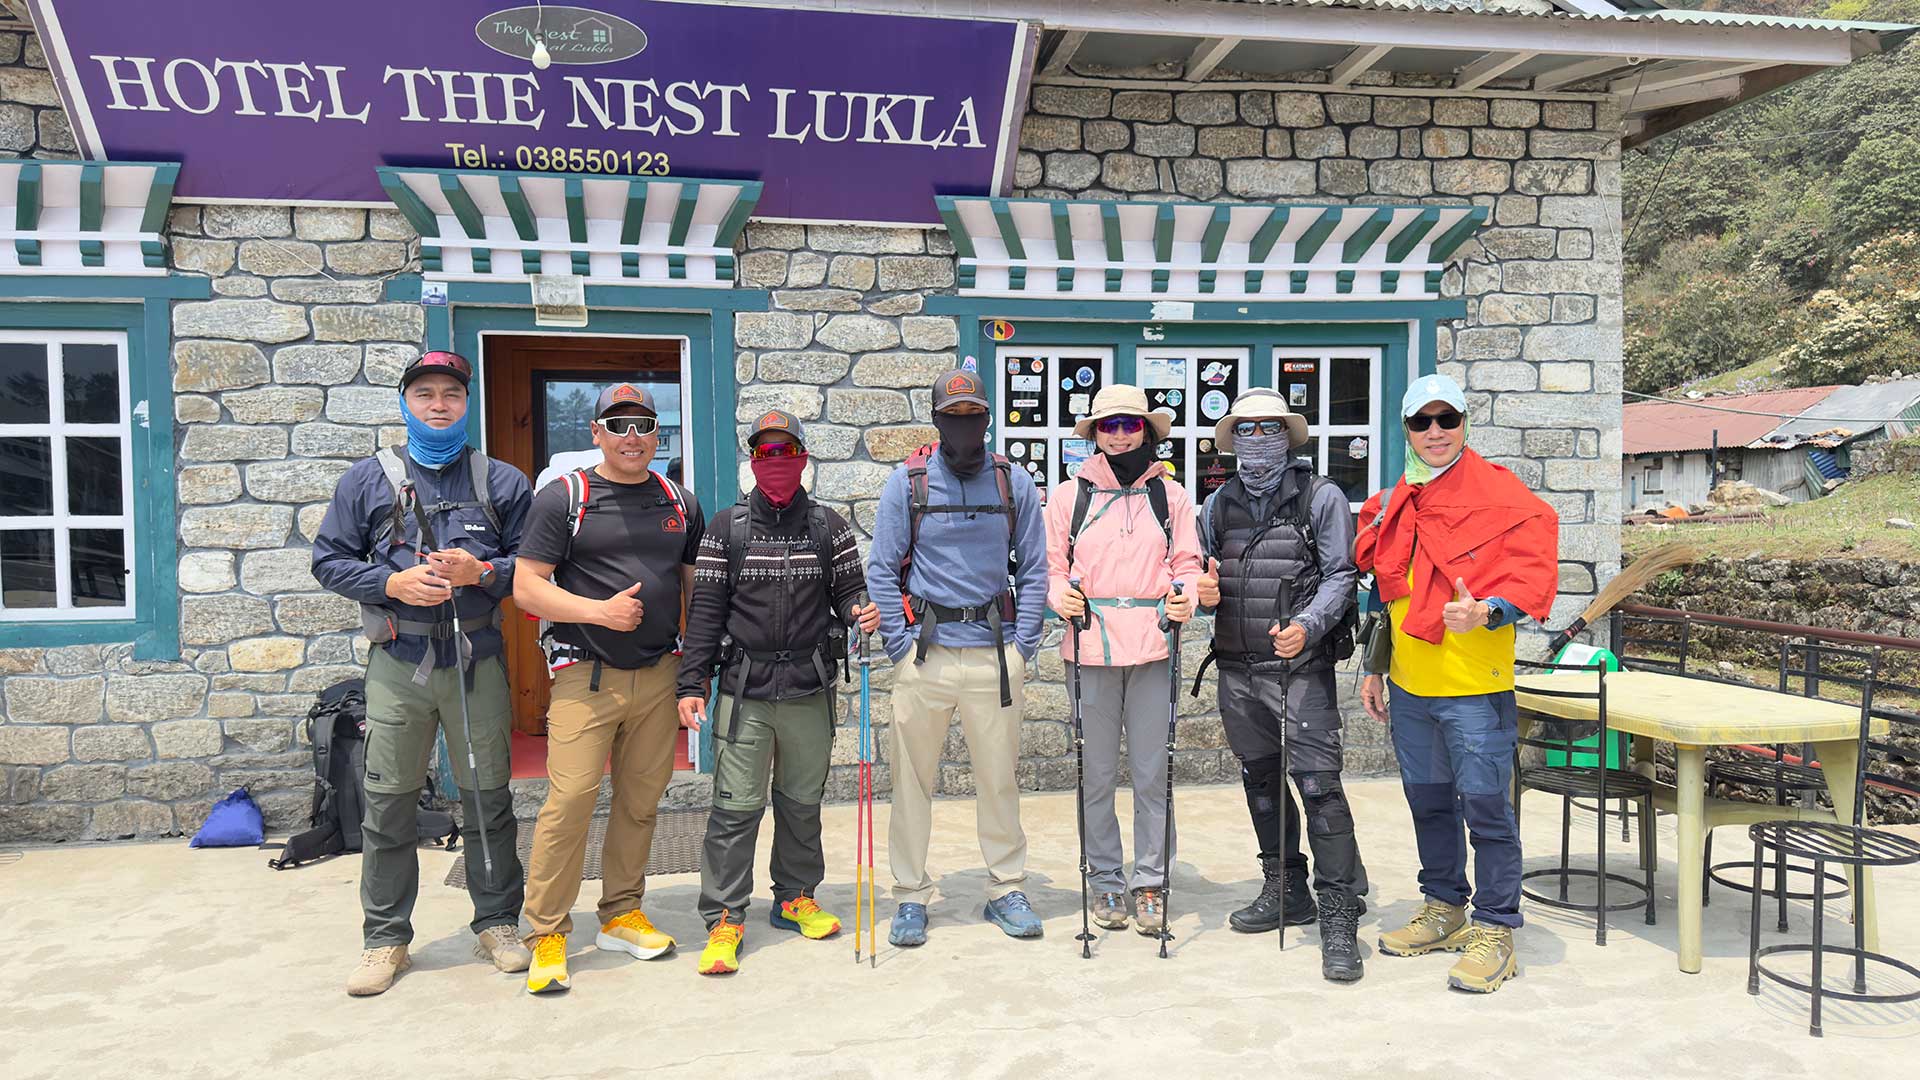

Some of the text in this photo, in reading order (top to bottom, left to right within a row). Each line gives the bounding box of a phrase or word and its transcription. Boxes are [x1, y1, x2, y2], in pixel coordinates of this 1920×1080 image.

[493, 21, 525, 35] The
[89, 55, 987, 151] HOTEL THE NEST LUKLA
[445, 143, 670, 176] Tel.: 038550123
